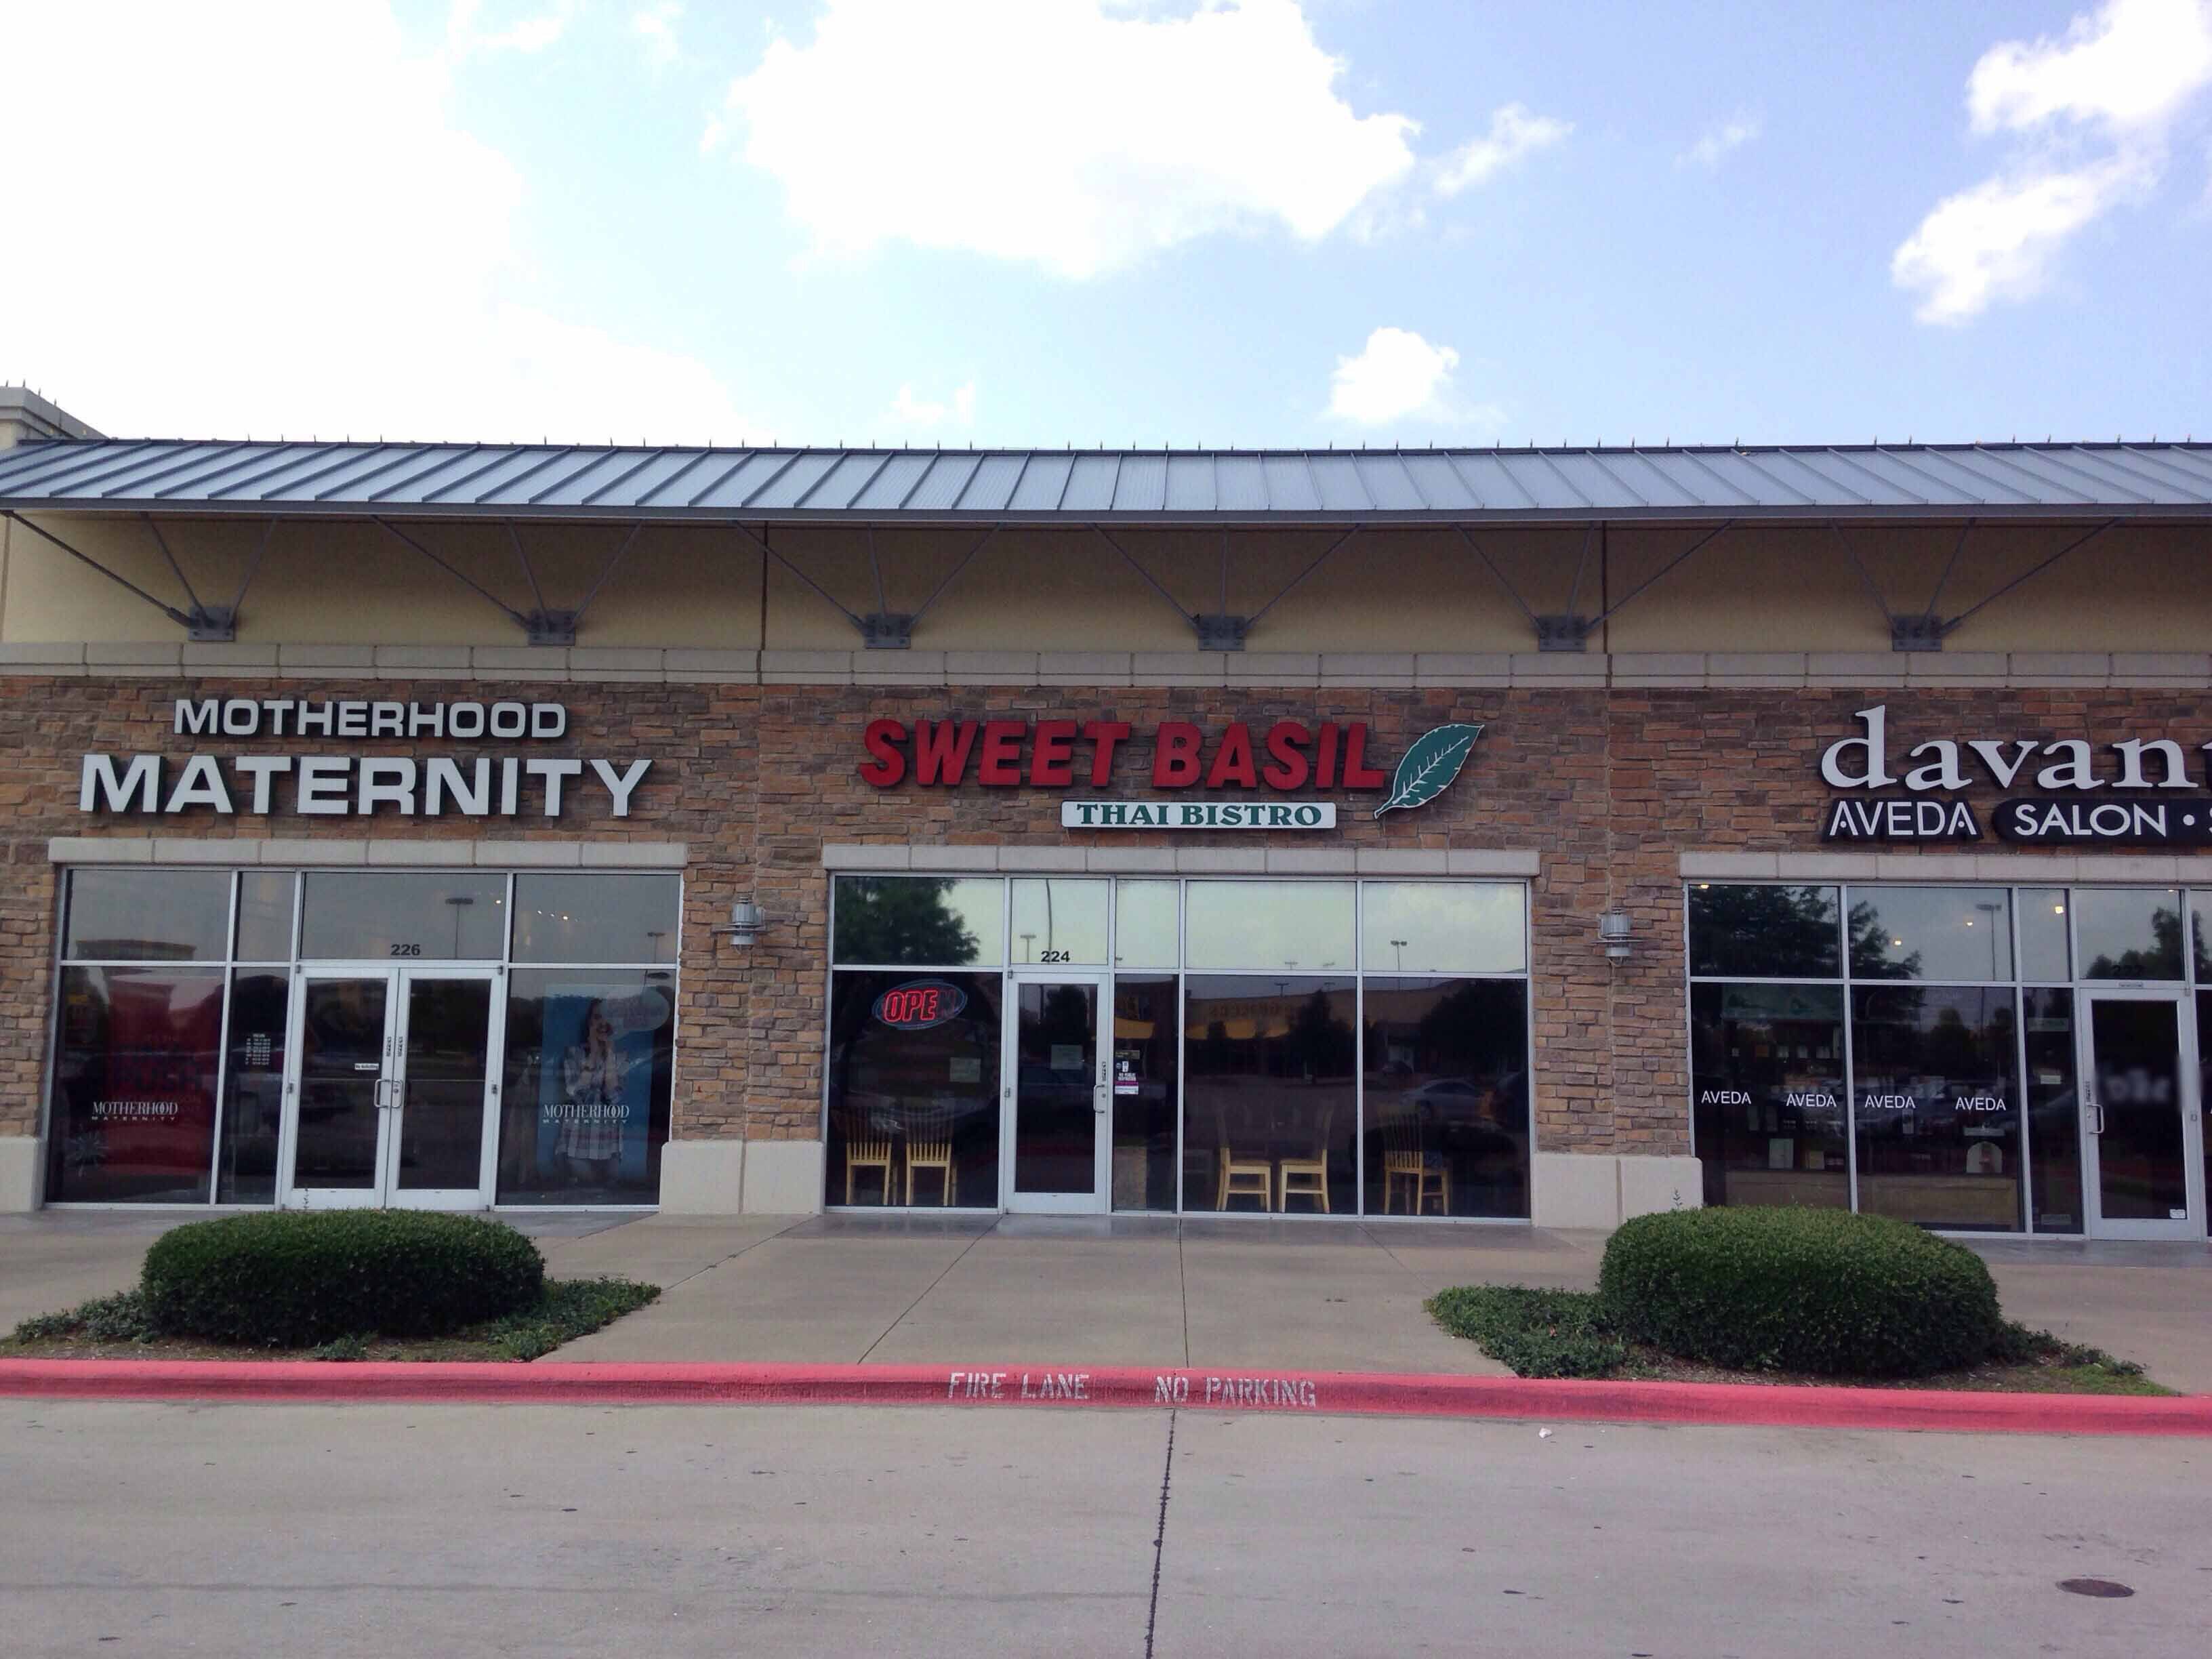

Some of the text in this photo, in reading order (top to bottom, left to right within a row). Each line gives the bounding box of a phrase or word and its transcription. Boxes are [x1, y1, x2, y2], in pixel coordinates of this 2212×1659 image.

[173, 699, 567, 739] MOTHERHOOD
[859, 718, 1385, 790] SWEET BASIL
[1820, 704, 2212, 790] davan
[79, 754, 653, 817] MATERNITY
[1076, 804, 1322, 827] THAI BISTRO
[1829, 800, 1977, 836] AVEDA
[2014, 803, 2167, 838] SALON
[390, 943, 420, 956] 226
[1041, 950, 1071, 962] 224
[1701, 1090, 1752, 1105] AVEDA
[1786, 1093, 1837, 1107] AVEDA
[1864, 1094, 1916, 1109] AVEDA
[1955, 1097, 2007, 1111] AVEDA
[92, 1101, 178, 1115] MOTHERHOOD
[543, 1104, 630, 1118] MOTHERHOOD
[949, 1372, 1090, 1400] FIRE LANE
[1154, 1376, 1317, 1408] NO PARKING
